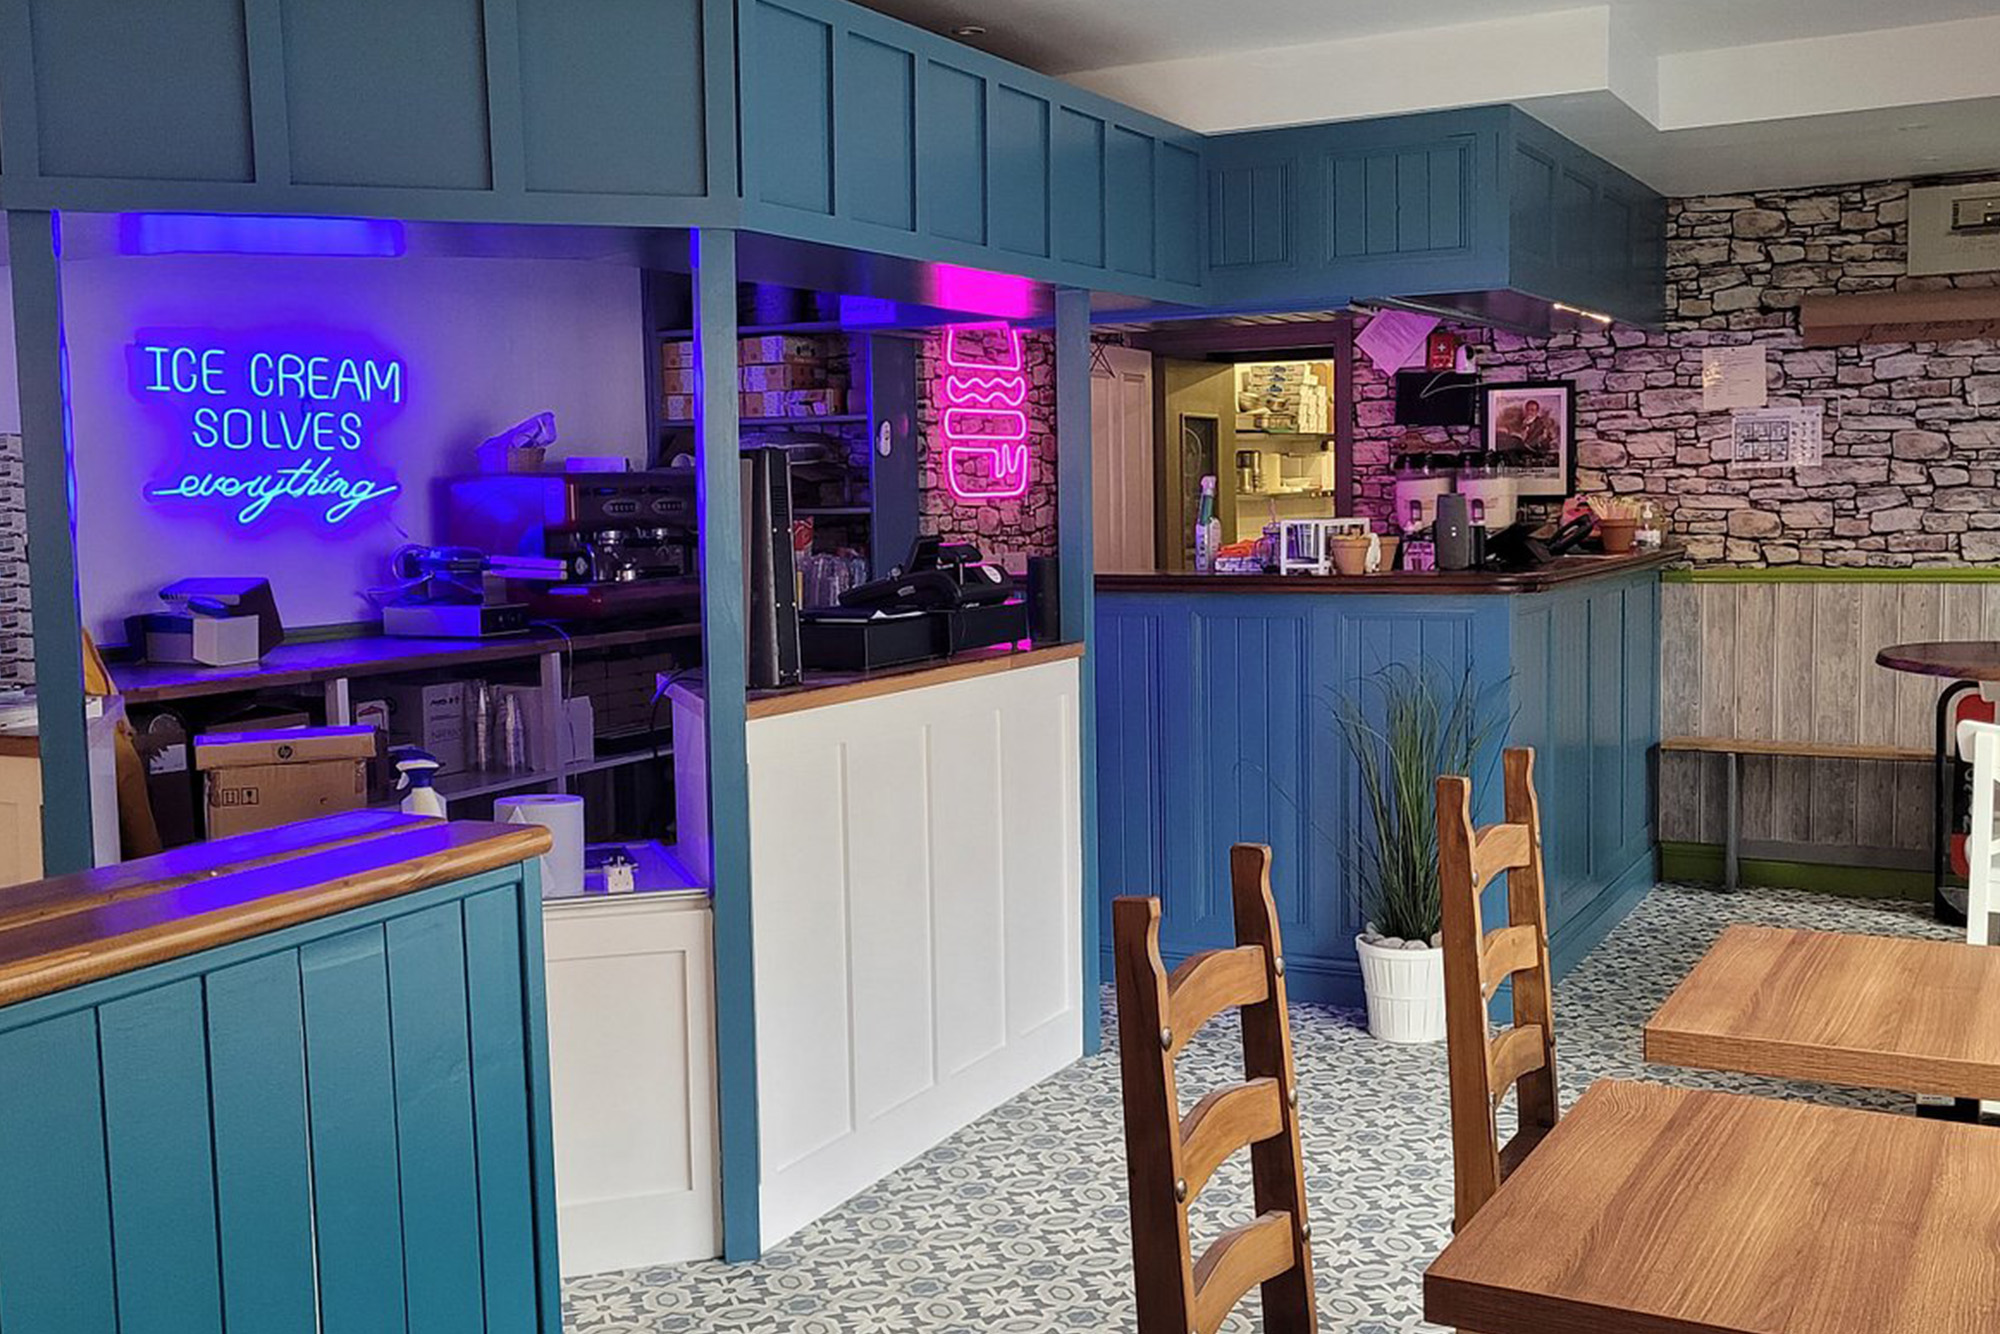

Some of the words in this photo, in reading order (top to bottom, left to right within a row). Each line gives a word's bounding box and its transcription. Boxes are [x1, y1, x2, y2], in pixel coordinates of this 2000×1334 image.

[144, 346, 227, 395] ICE
[250, 352, 401, 404] CREAM
[192, 407, 363, 451] SOLVES
[151, 456, 399, 524] everything
